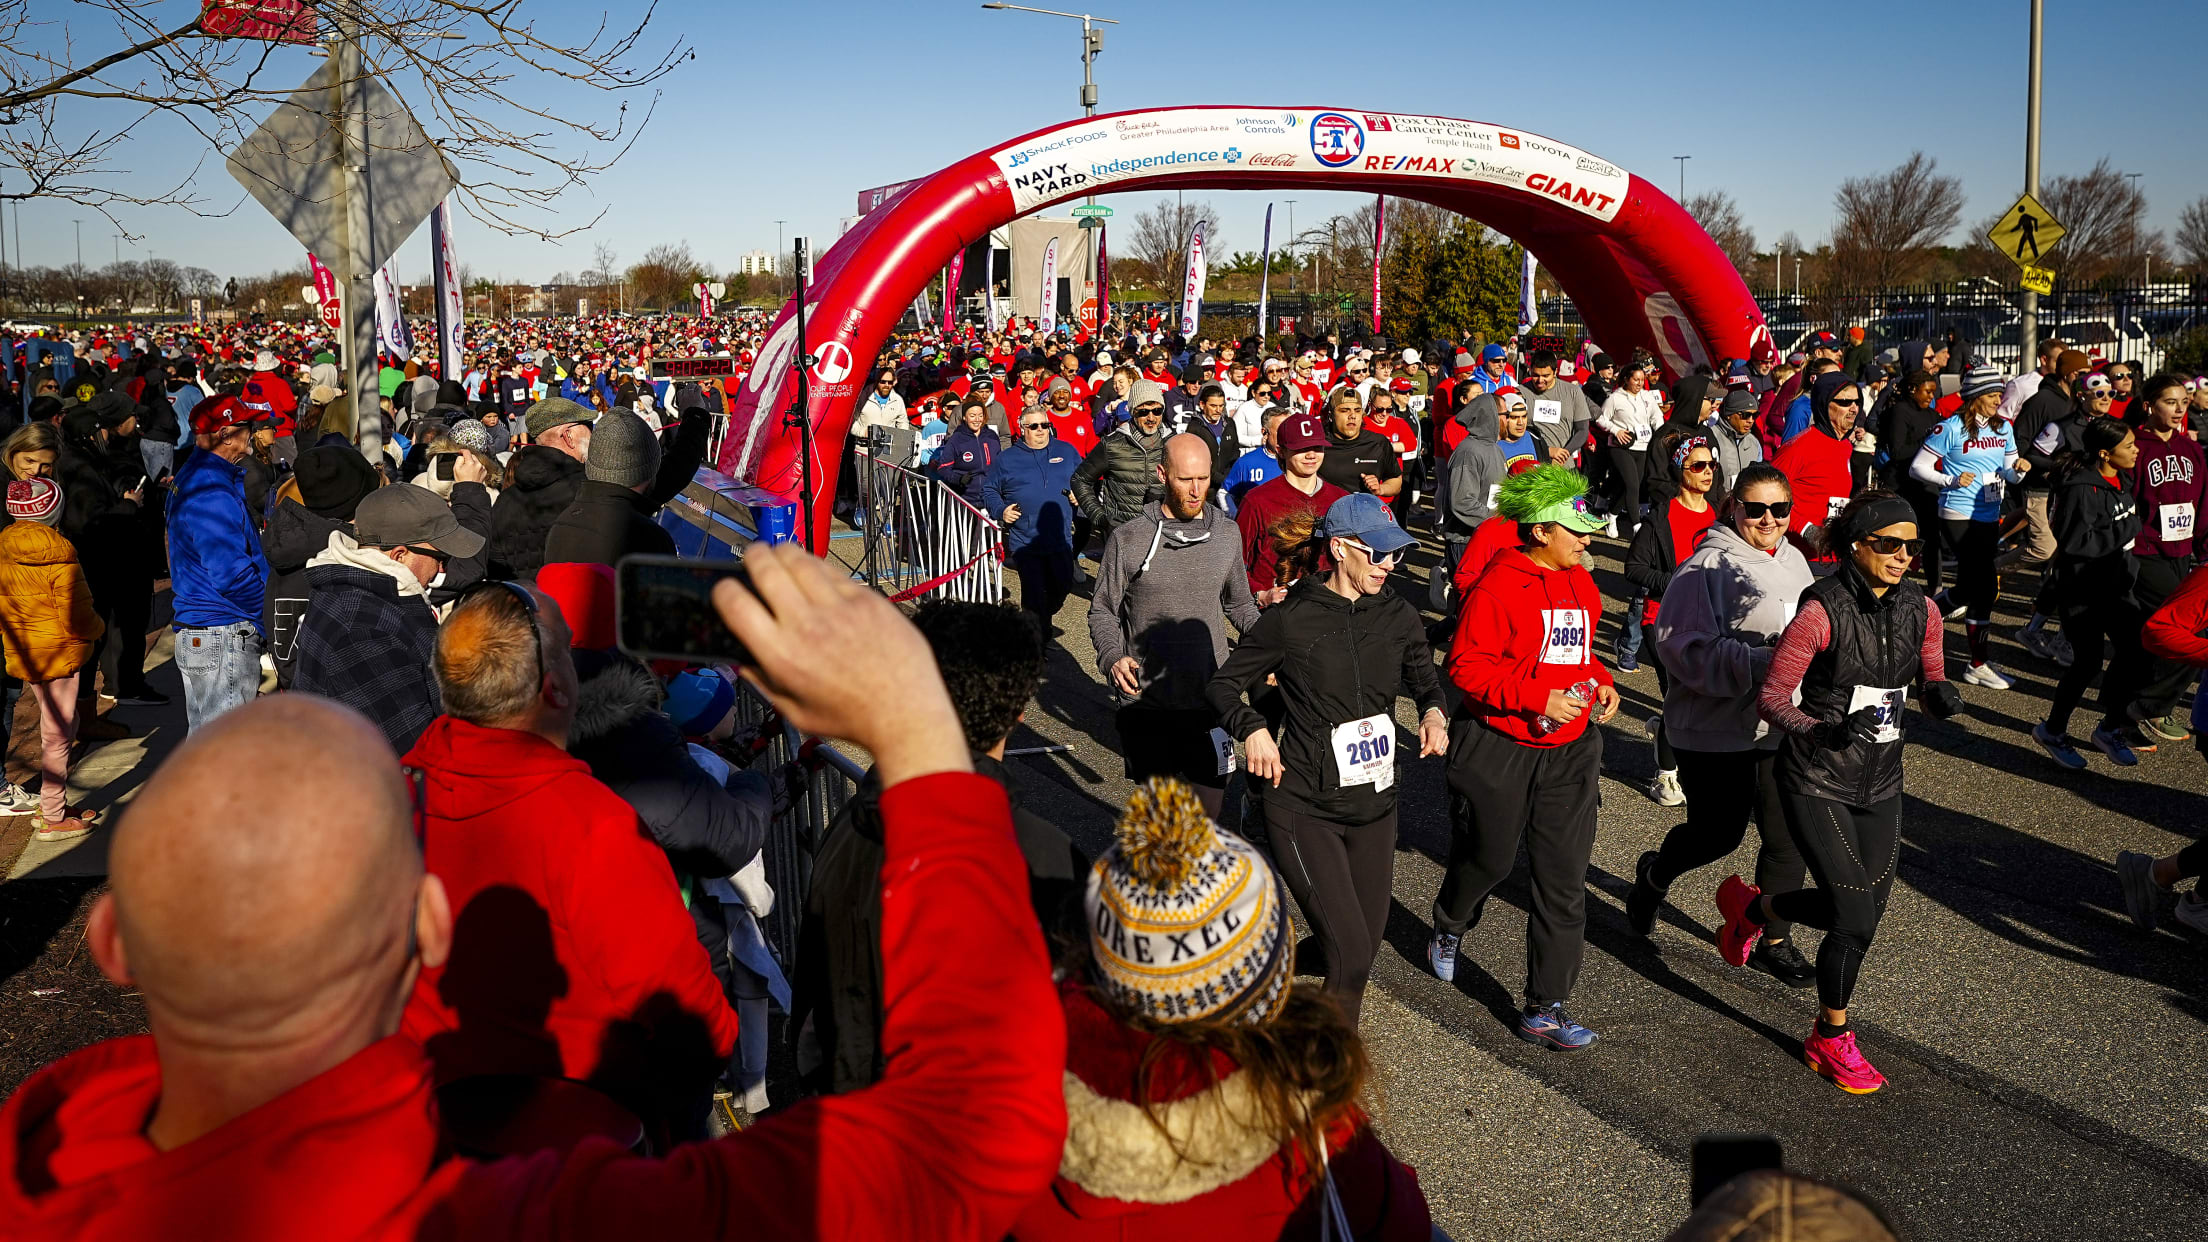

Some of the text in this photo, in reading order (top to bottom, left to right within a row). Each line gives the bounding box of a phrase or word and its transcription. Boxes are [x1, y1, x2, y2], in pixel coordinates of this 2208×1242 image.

[1236, 117, 1276, 126] Johnson
[1244, 125, 1286, 134] Controls
[1392, 115, 1471, 130] Fox Chase
[1120, 124, 1230, 141] Greater Philadelphia Area
[1395, 124, 1492, 141] Cancer Center
[1425, 136, 1493, 151] Temple Health
[1524, 140, 1571, 160] TOYOTA
[1091, 150, 1219, 177] Independence
[1364, 155, 1456, 174] RE/MAX
[1477, 161, 1524, 178] NovaCare
[1015, 162, 1068, 189] NAVY
[1034, 173, 1087, 195] YARD
[1525, 173, 1616, 212] GIANT
[1045, 248, 1054, 314] START
[1187, 234, 1202, 312] START
[2025, 271, 2051, 288] AHEAD
[324, 306, 341, 320] ST
[1081, 306, 1098, 320] ST
[810, 383, 854, 392] OUR PEOPLE
[1300, 420, 1314, 437] C
[1250, 468, 1264, 482] 10
[2147, 454, 2194, 487] GAP
[2168, 514, 2192, 529] 5422
[1551, 627, 1584, 647] 3892
[1346, 734, 1390, 766] 2810
